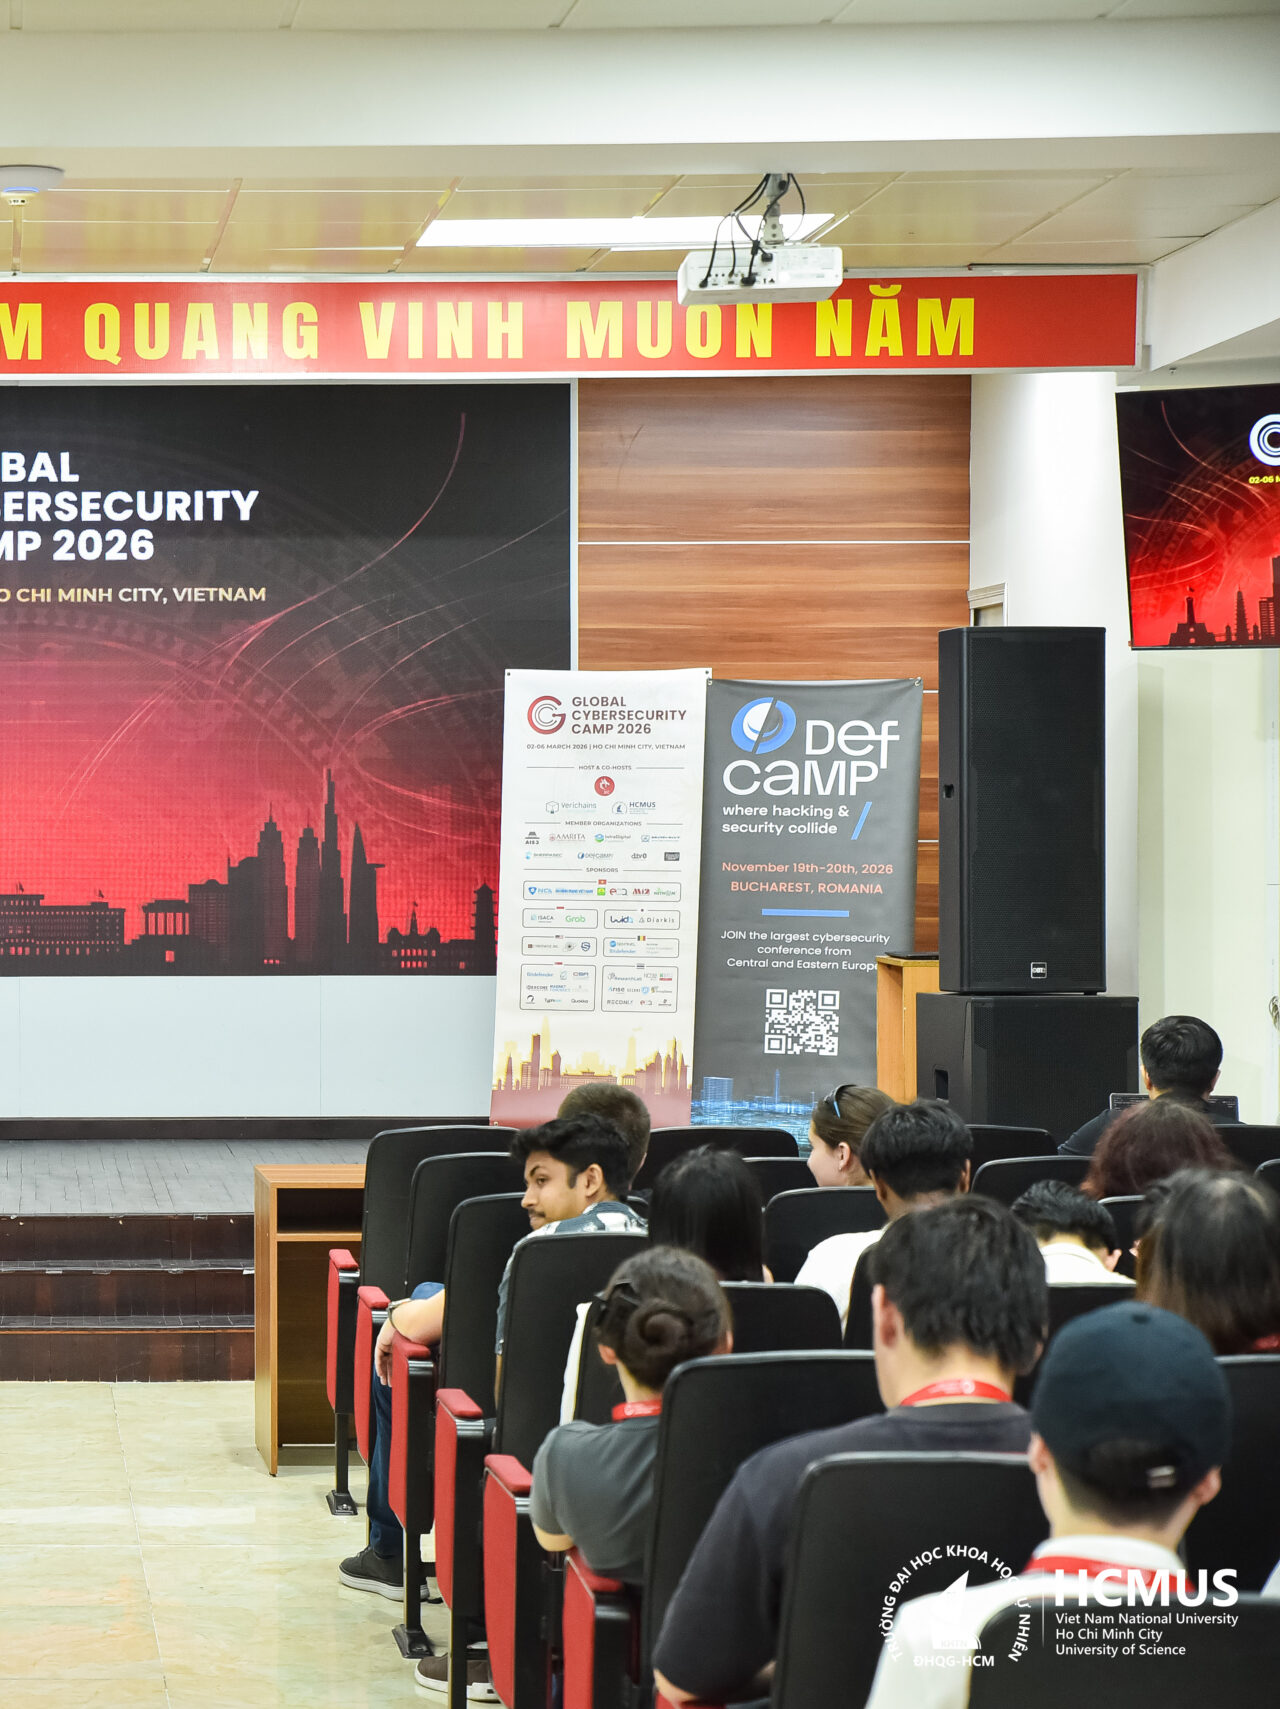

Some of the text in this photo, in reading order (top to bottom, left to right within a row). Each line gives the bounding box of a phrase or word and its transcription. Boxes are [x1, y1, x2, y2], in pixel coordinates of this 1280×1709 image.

[83, 301, 321, 366] QUANG
[358, 301, 524, 360] VINH
[815, 284, 975, 358] NĂM
[52, 529, 155, 561] 2026
[16, 588, 53, 603] CHI
[58, 587, 114, 603] MINH
[118, 587, 168, 606] CITY,
[172, 587, 267, 602] VIETNAM
[572, 696, 626, 707] GLOBAL
[571, 709, 687, 721] CYBERSECURITY
[571, 723, 651, 734] CAMP 2026
[722, 804, 850, 819] where hacking &
[722, 822, 838, 836] security collide
[722, 862, 789, 873] November
[861, 864, 893, 874] 2026
[730, 881, 883, 894] BUCHAREST, ROMANIA
[721, 930, 890, 945] JOIN the largest cybersecurity
[757, 944, 852, 956] conference from
[726, 957, 769, 968] Central
[771, 958, 794, 969] and
[796, 959, 839, 970] Eastern
